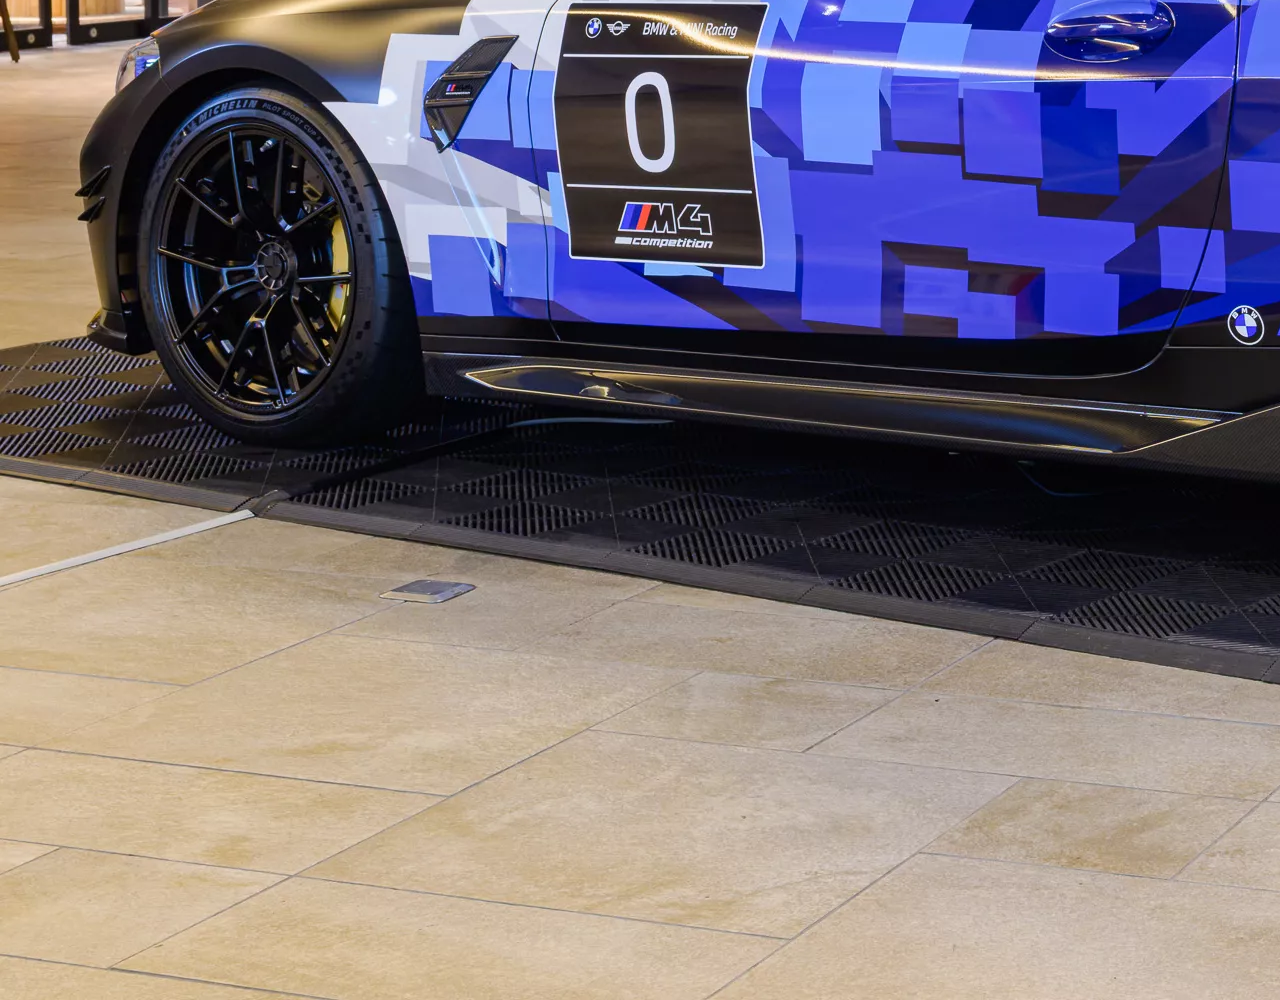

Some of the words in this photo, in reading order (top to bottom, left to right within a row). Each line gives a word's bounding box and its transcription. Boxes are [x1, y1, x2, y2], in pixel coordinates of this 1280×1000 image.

[642, 22, 669, 36] BMW
[669, 22, 679, 36] &
[705, 22, 738, 39] Racing
[199, 100, 259, 124] MICHELIN
[624, 71, 675, 173] 0
[631, 236, 713, 249] competition
